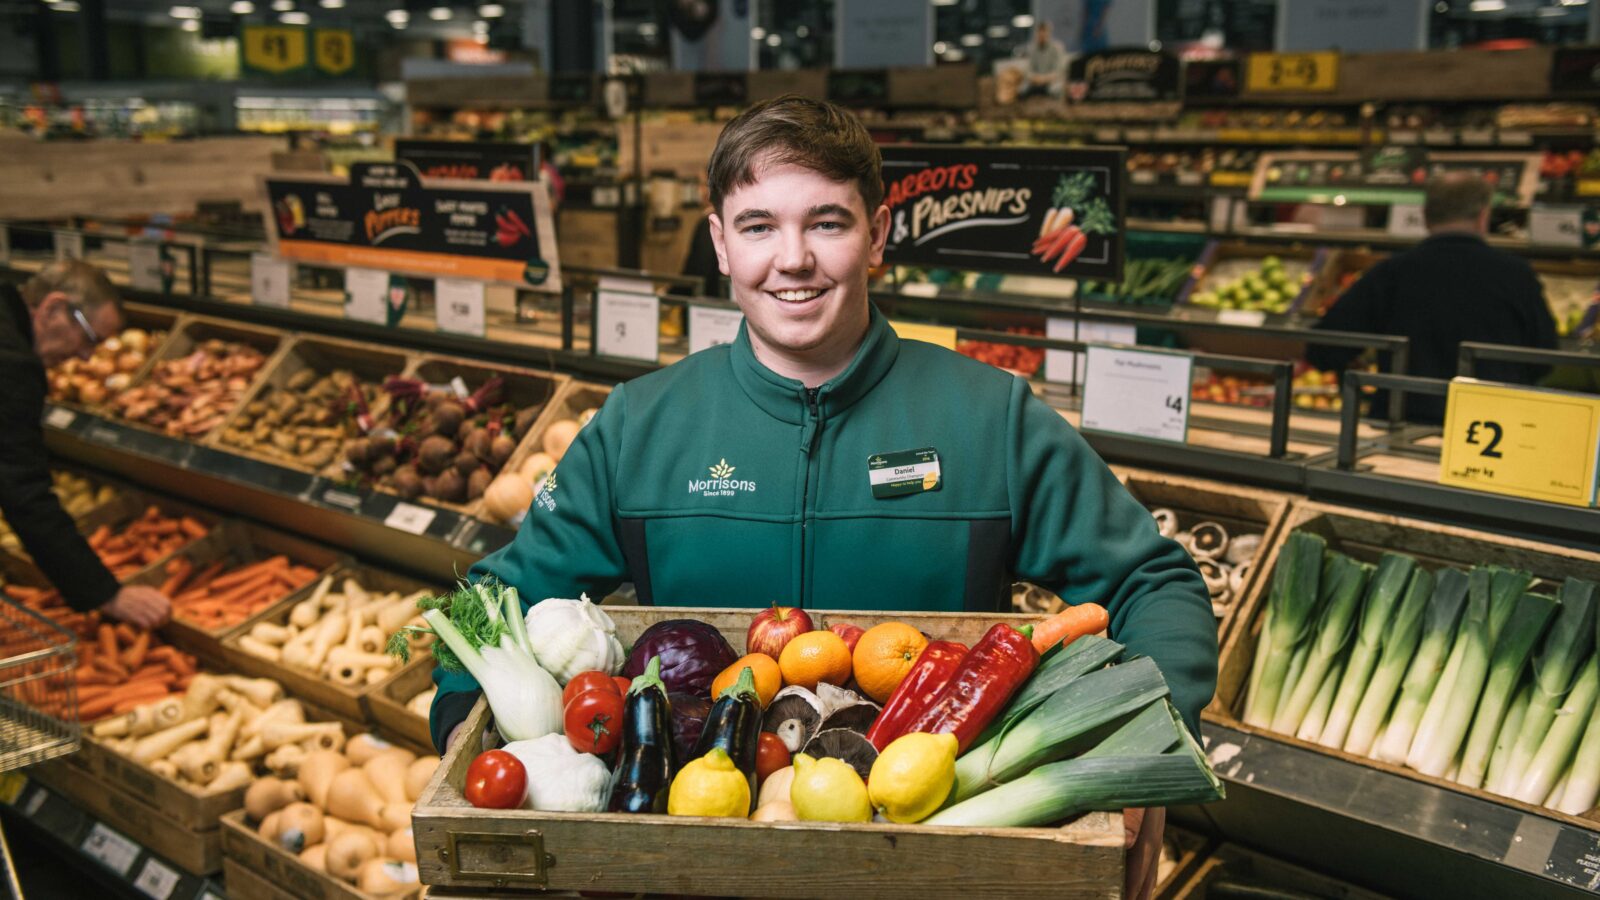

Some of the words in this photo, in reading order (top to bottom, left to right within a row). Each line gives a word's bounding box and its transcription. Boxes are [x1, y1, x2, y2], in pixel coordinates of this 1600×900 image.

[893, 210, 909, 244] &
[1466, 420, 1503, 459] £2
[895, 467, 915, 475] Daniel
[688, 477, 756, 494] Morrisons
